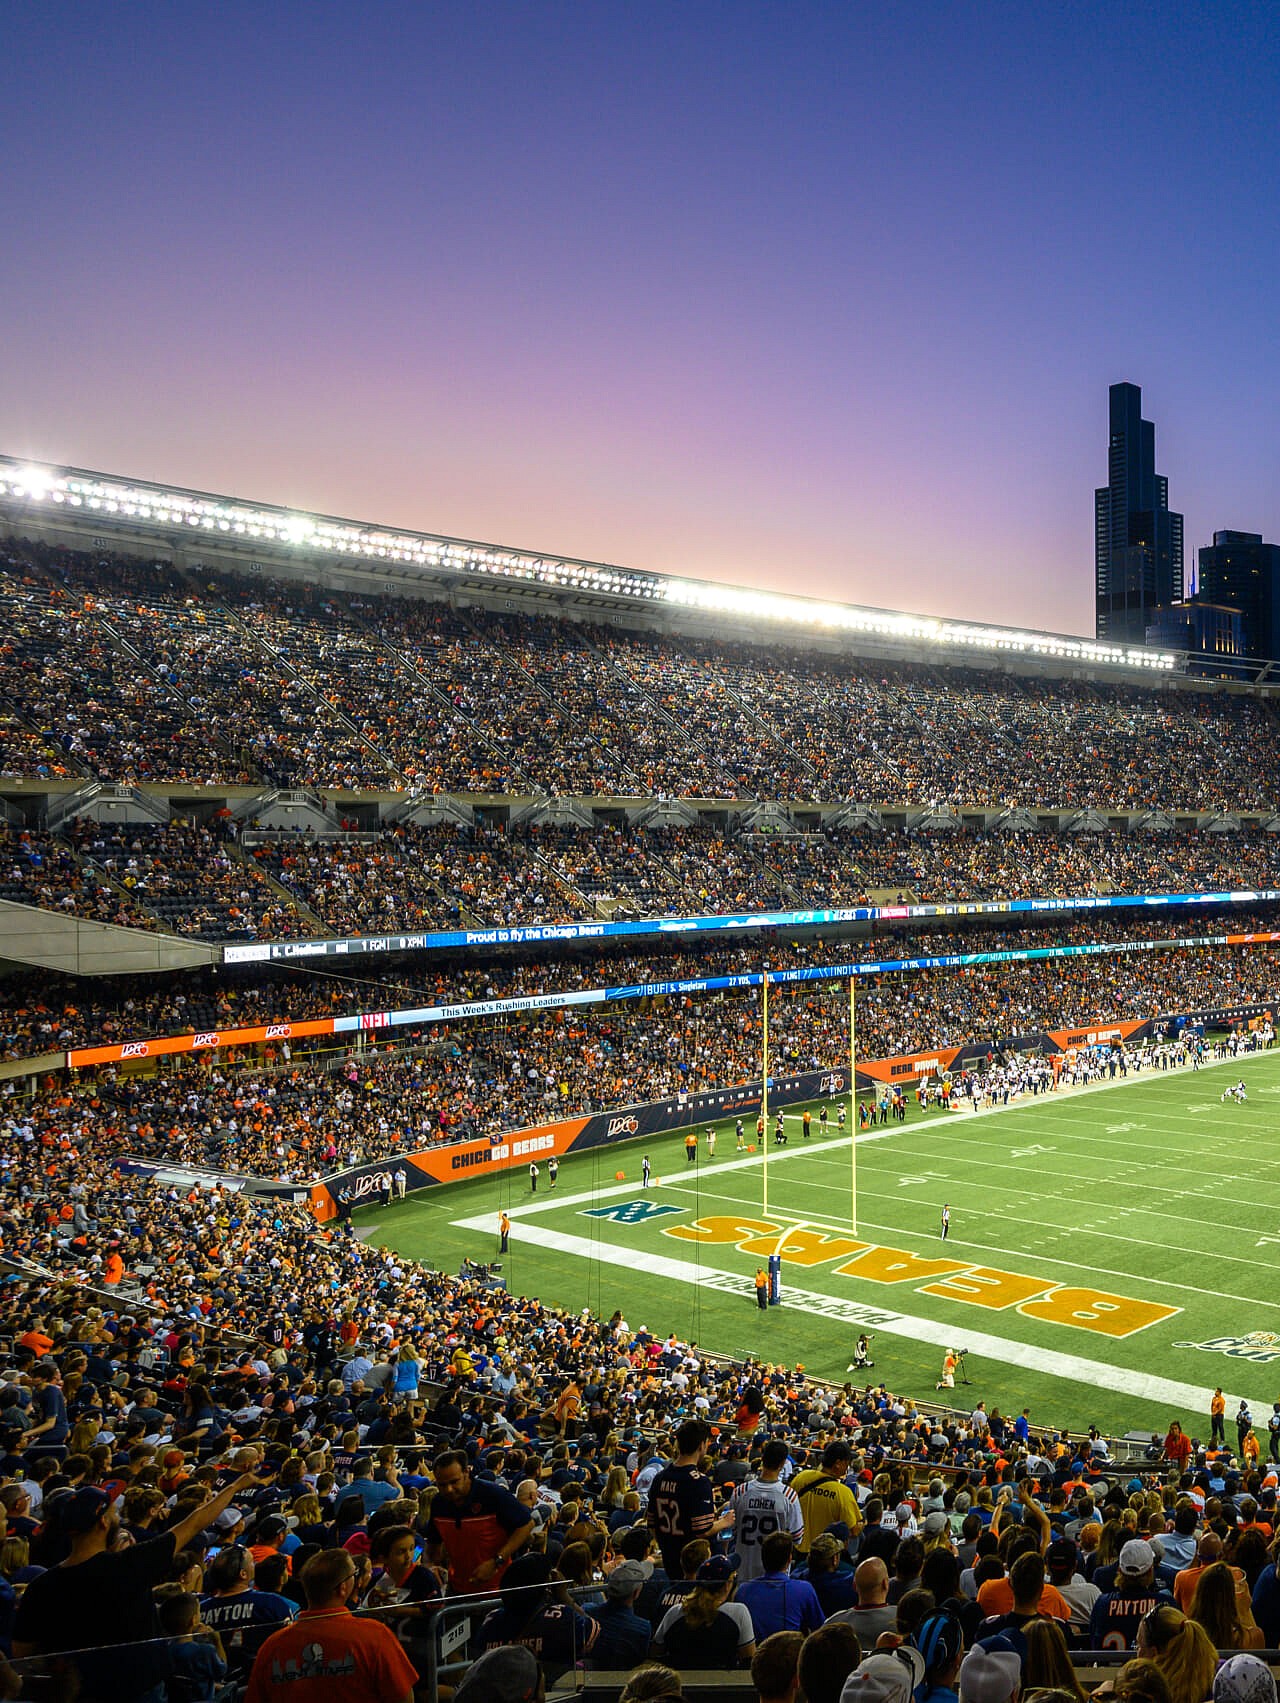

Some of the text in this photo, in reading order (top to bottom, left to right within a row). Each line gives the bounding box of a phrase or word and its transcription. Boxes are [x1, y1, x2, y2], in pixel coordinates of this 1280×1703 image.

[466, 925, 604, 944] Proud to fly the Chicago Bears
[646, 983, 666, 996] BUF
[678, 981, 707, 993] Singletary
[440, 996, 566, 1018] This Week's Rushing Leaders
[360, 1013, 391, 1030] NFL
[451, 1134, 555, 1170] CHICAGO BEARS
[660, 1214, 1185, 1339] BEARS
[660, 1480, 677, 1494] MACK
[748, 1498, 776, 1509] COHEN
[655, 1498, 685, 1536] 52
[199, 1602, 255, 1625] PAYTON
[1109, 1599, 1156, 1617] PAYTON
